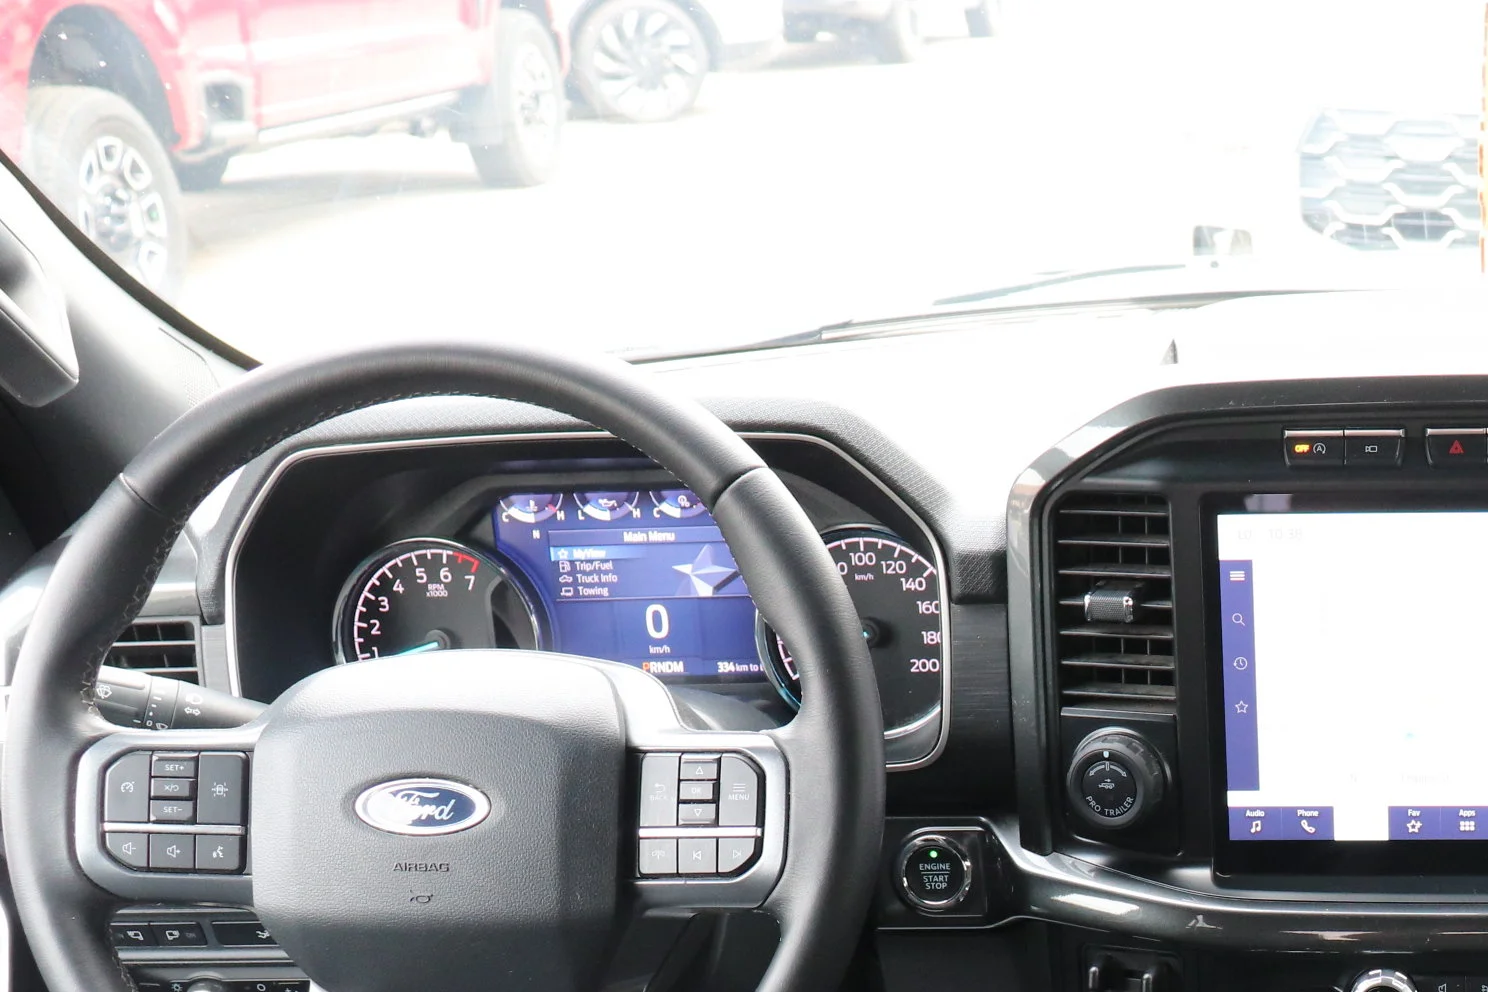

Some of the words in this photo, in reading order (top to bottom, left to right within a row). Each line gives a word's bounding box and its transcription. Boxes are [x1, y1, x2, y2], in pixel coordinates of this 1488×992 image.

[1294, 444, 1310, 453] OFF
[556, 510, 564, 520] H
[632, 508, 641, 518] H
[532, 530, 540, 540] N
[623, 531, 648, 542] Main
[648, 531, 675, 542] Menu
[850, 552, 876, 566] 100
[574, 560, 614, 572] Trip/Fuel
[880, 560, 907, 575] 120
[415, 568, 427, 584] 5
[440, 568, 452, 583] 6
[576, 573, 600, 583] Truck
[600, 572, 618, 582] Info
[854, 573, 874, 581] km/h
[392, 579, 404, 594] 4
[464, 575, 476, 591] 7
[900, 577, 926, 592] 140
[426, 590, 448, 598] x1000
[578, 586, 609, 596] Towing
[378, 597, 390, 612] 3
[916, 600, 940, 614] 160
[370, 619, 381, 635] 2
[646, 604, 670, 640] 0
[372, 646, 378, 658] 1
[648, 645, 671, 654] km/h
[716, 662, 735, 673] 334
[736, 662, 748, 672] km
[910, 658, 940, 672] 200
[388, 790, 456, 822] Ford
[1086, 796, 1101, 812] PRO
[1104, 796, 1134, 816] TRAILER
[1246, 809, 1265, 818] Audio
[1297, 808, 1319, 818] Phone
[1408, 808, 1420, 817] Fav
[1458, 808, 1476, 818] Apps
[392, 862, 450, 873] AIRBAG
[919, 863, 950, 871] ENGINE
[925, 882, 948, 890] STOP
